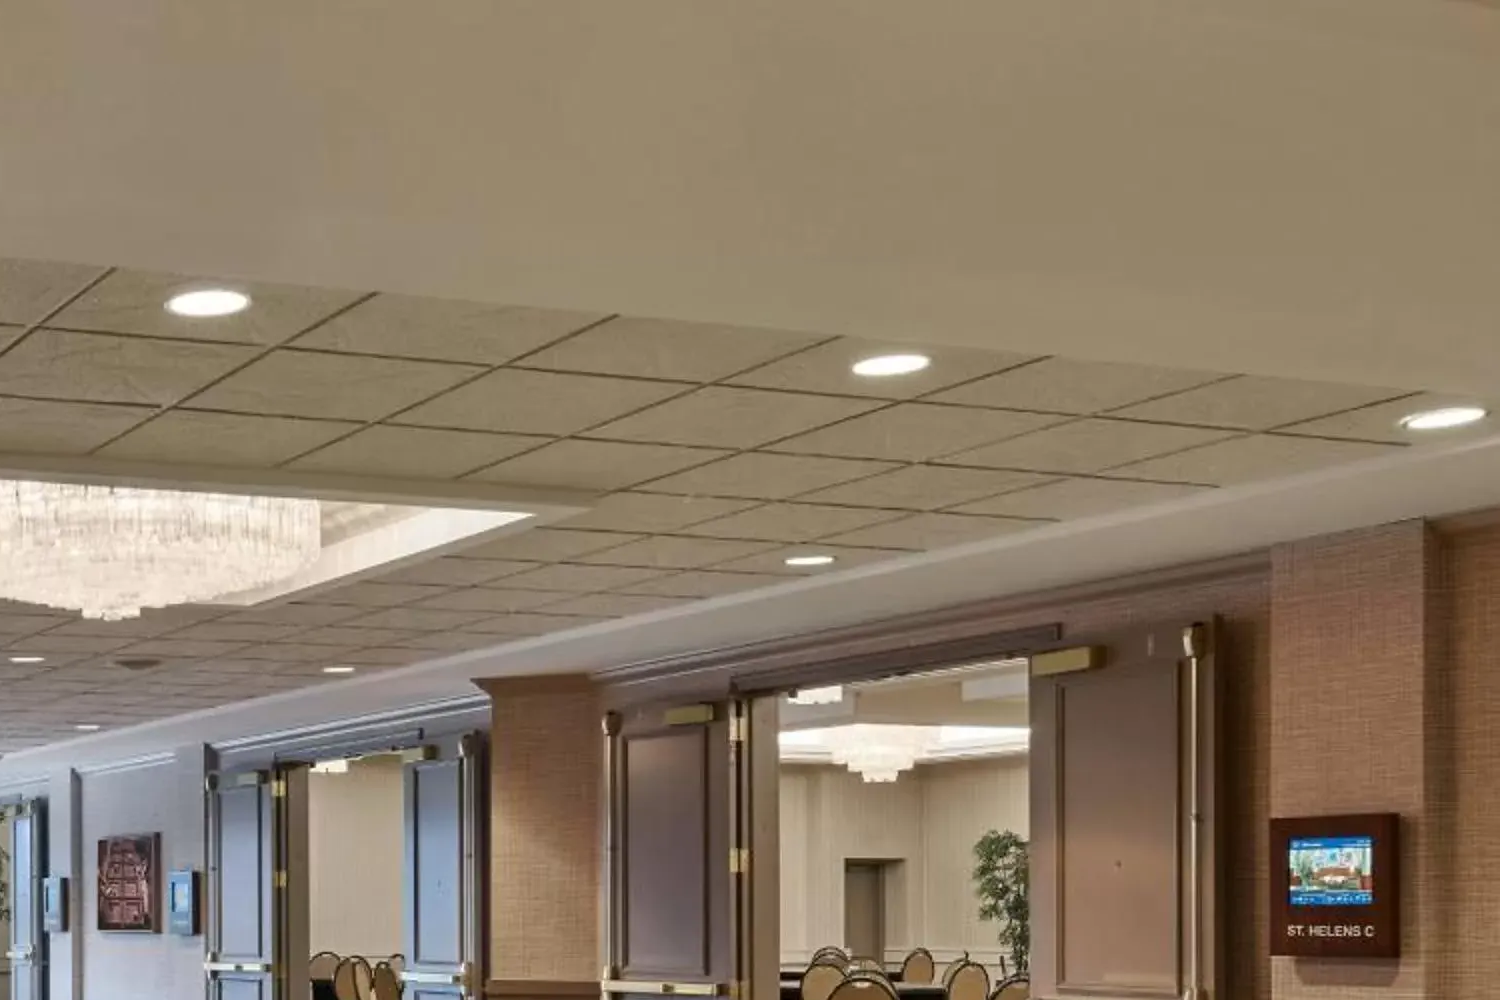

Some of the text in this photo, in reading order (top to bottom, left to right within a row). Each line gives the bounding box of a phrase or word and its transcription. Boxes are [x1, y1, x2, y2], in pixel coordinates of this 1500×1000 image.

[1287, 924, 1375, 937] ST. HELENS C
